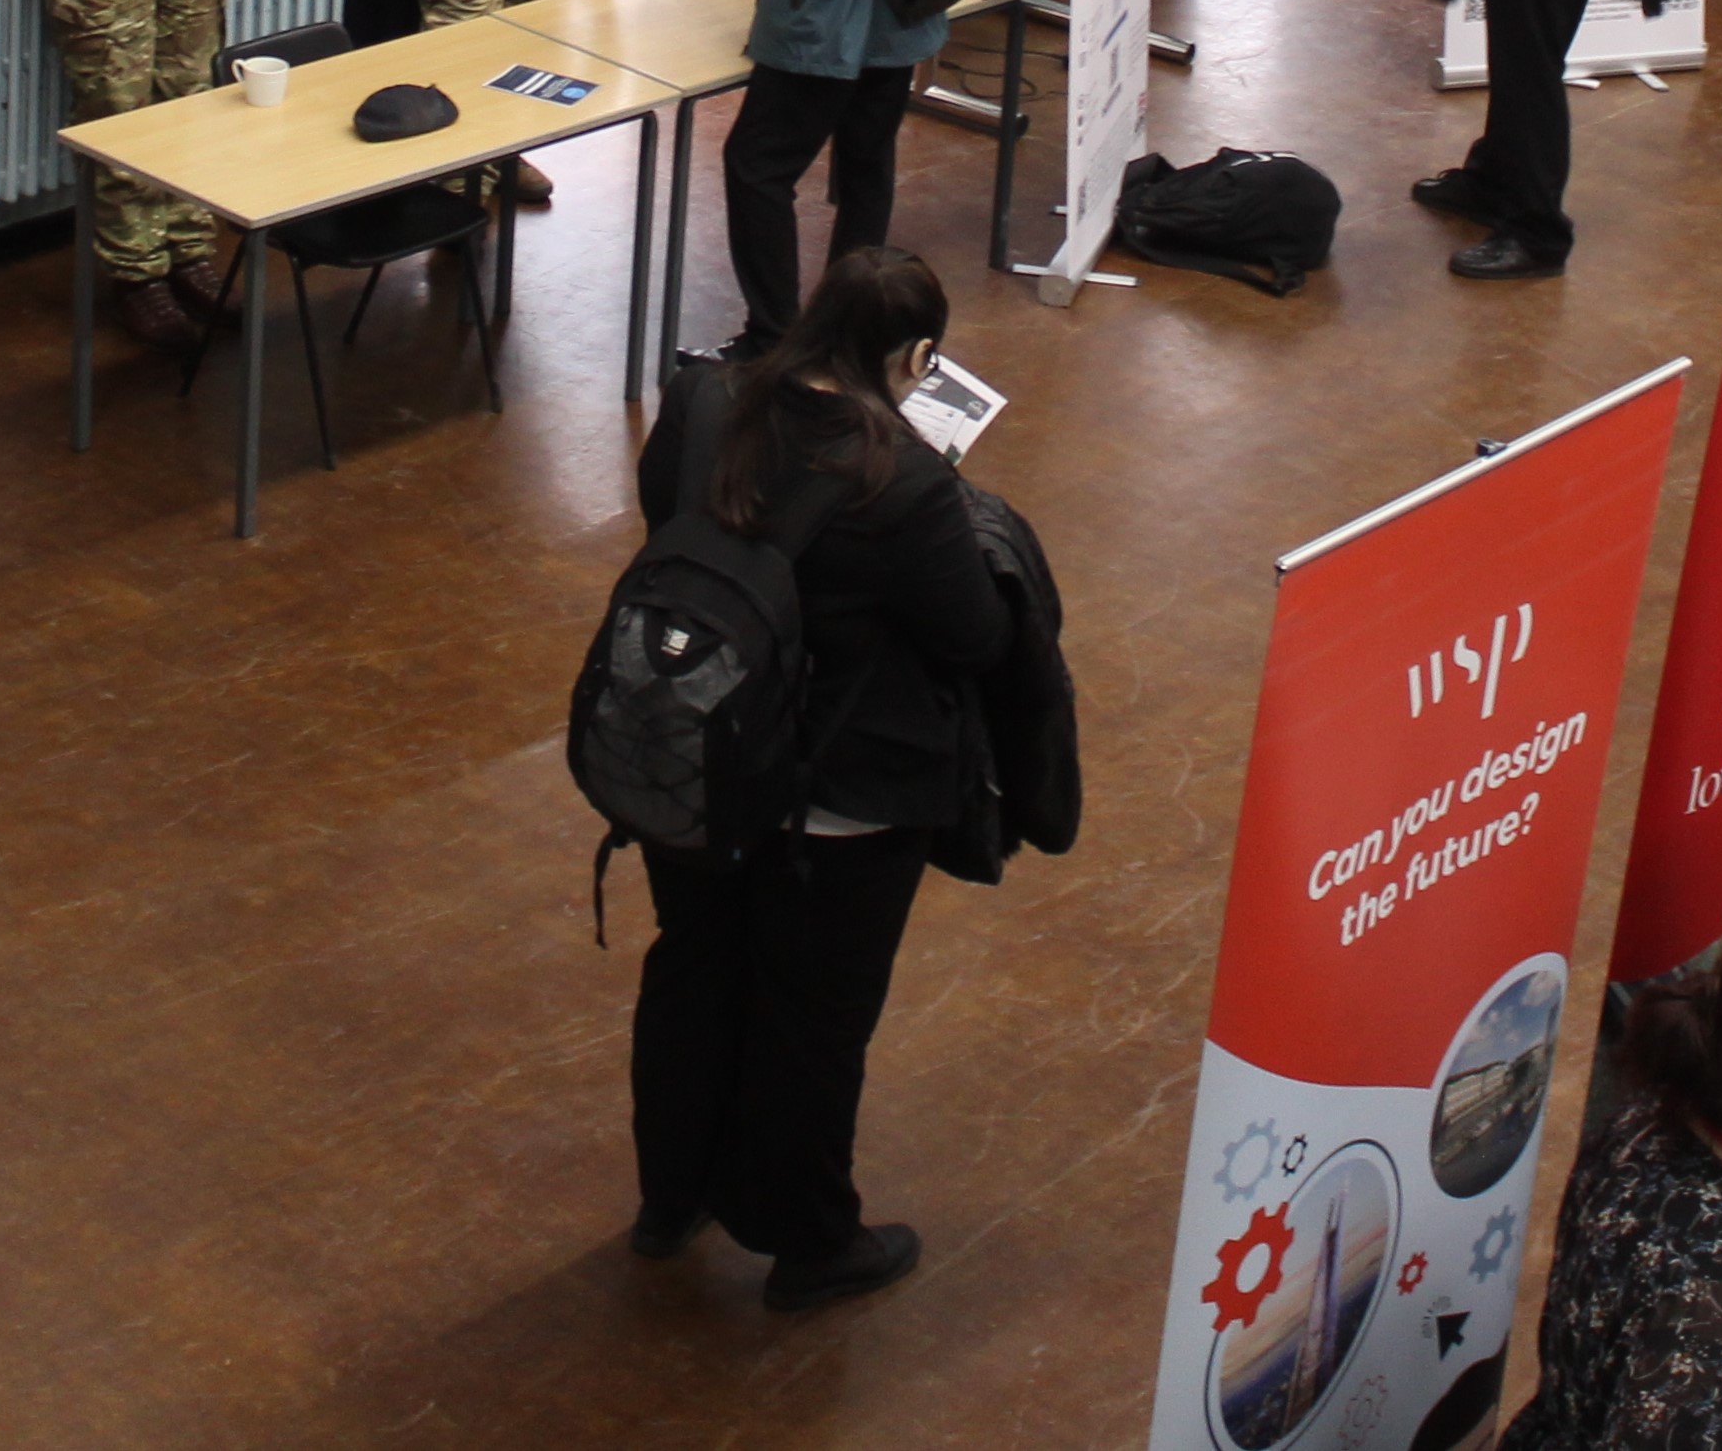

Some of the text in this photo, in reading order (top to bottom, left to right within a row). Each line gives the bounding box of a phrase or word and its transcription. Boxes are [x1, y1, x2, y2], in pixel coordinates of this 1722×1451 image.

[1308, 711, 1588, 901] Can you design
[1339, 791, 1540, 947] the future?
